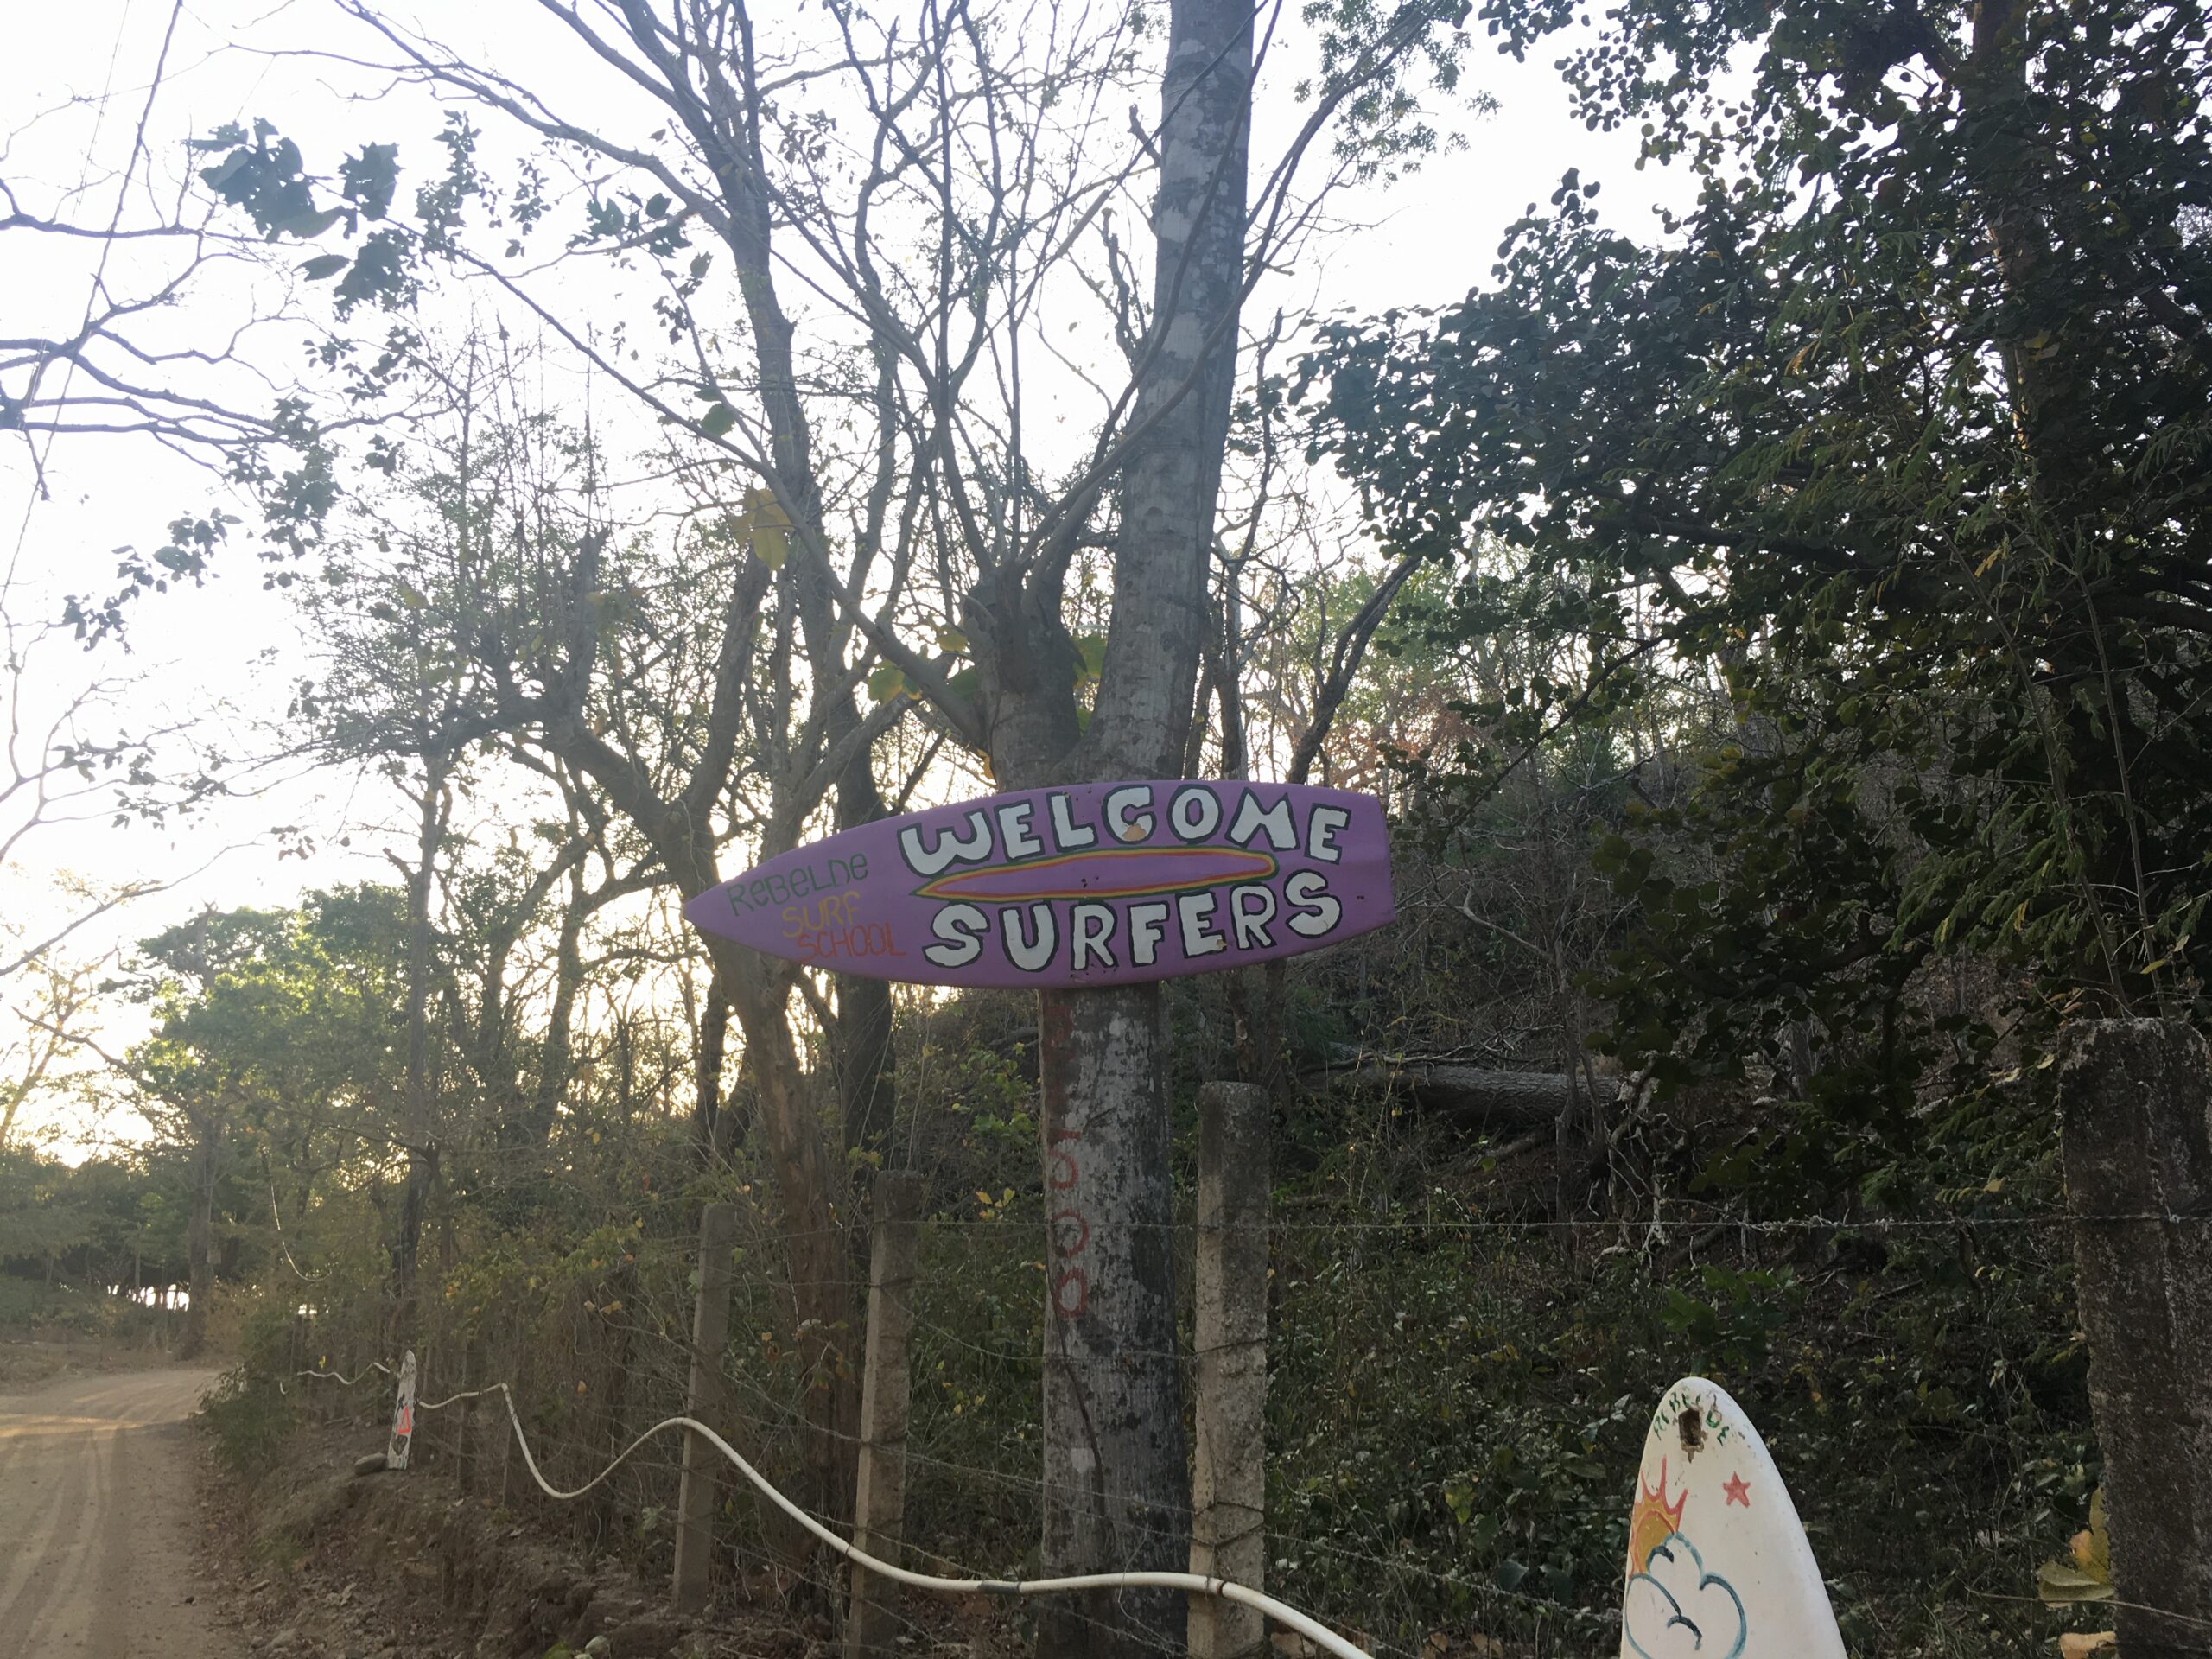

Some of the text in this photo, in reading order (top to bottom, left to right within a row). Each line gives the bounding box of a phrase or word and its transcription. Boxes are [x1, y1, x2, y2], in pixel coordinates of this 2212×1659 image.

[898, 785, 1351, 877] WELCOME
[781, 890, 860, 938] SURF
[796, 922, 906, 964] SCHOOL
[922, 868, 1343, 971] SURFERS
